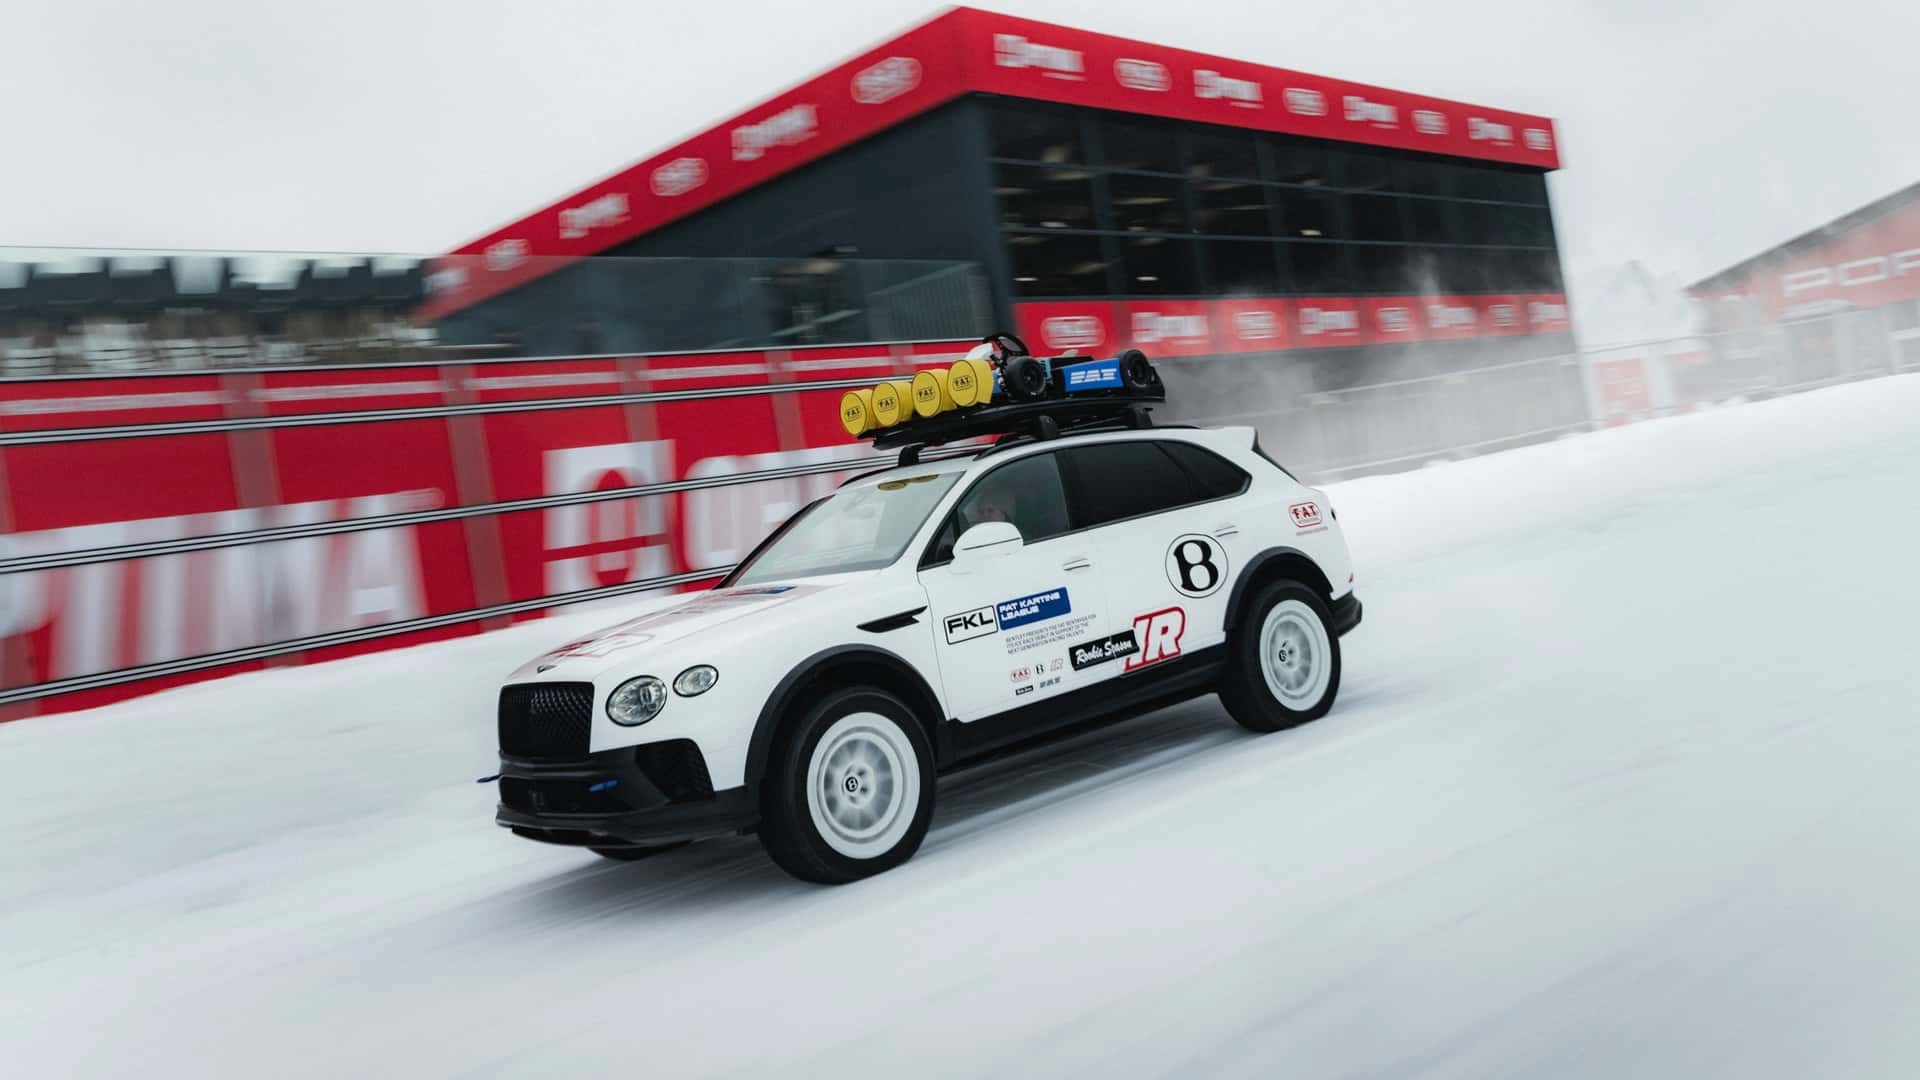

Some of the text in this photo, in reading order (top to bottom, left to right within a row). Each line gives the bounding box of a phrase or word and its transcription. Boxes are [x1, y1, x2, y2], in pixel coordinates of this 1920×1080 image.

[1019, 591, 1061, 608] KARTING
[1000, 605, 1040, 621] LEAGUE
[947, 612, 994, 634] FKL
